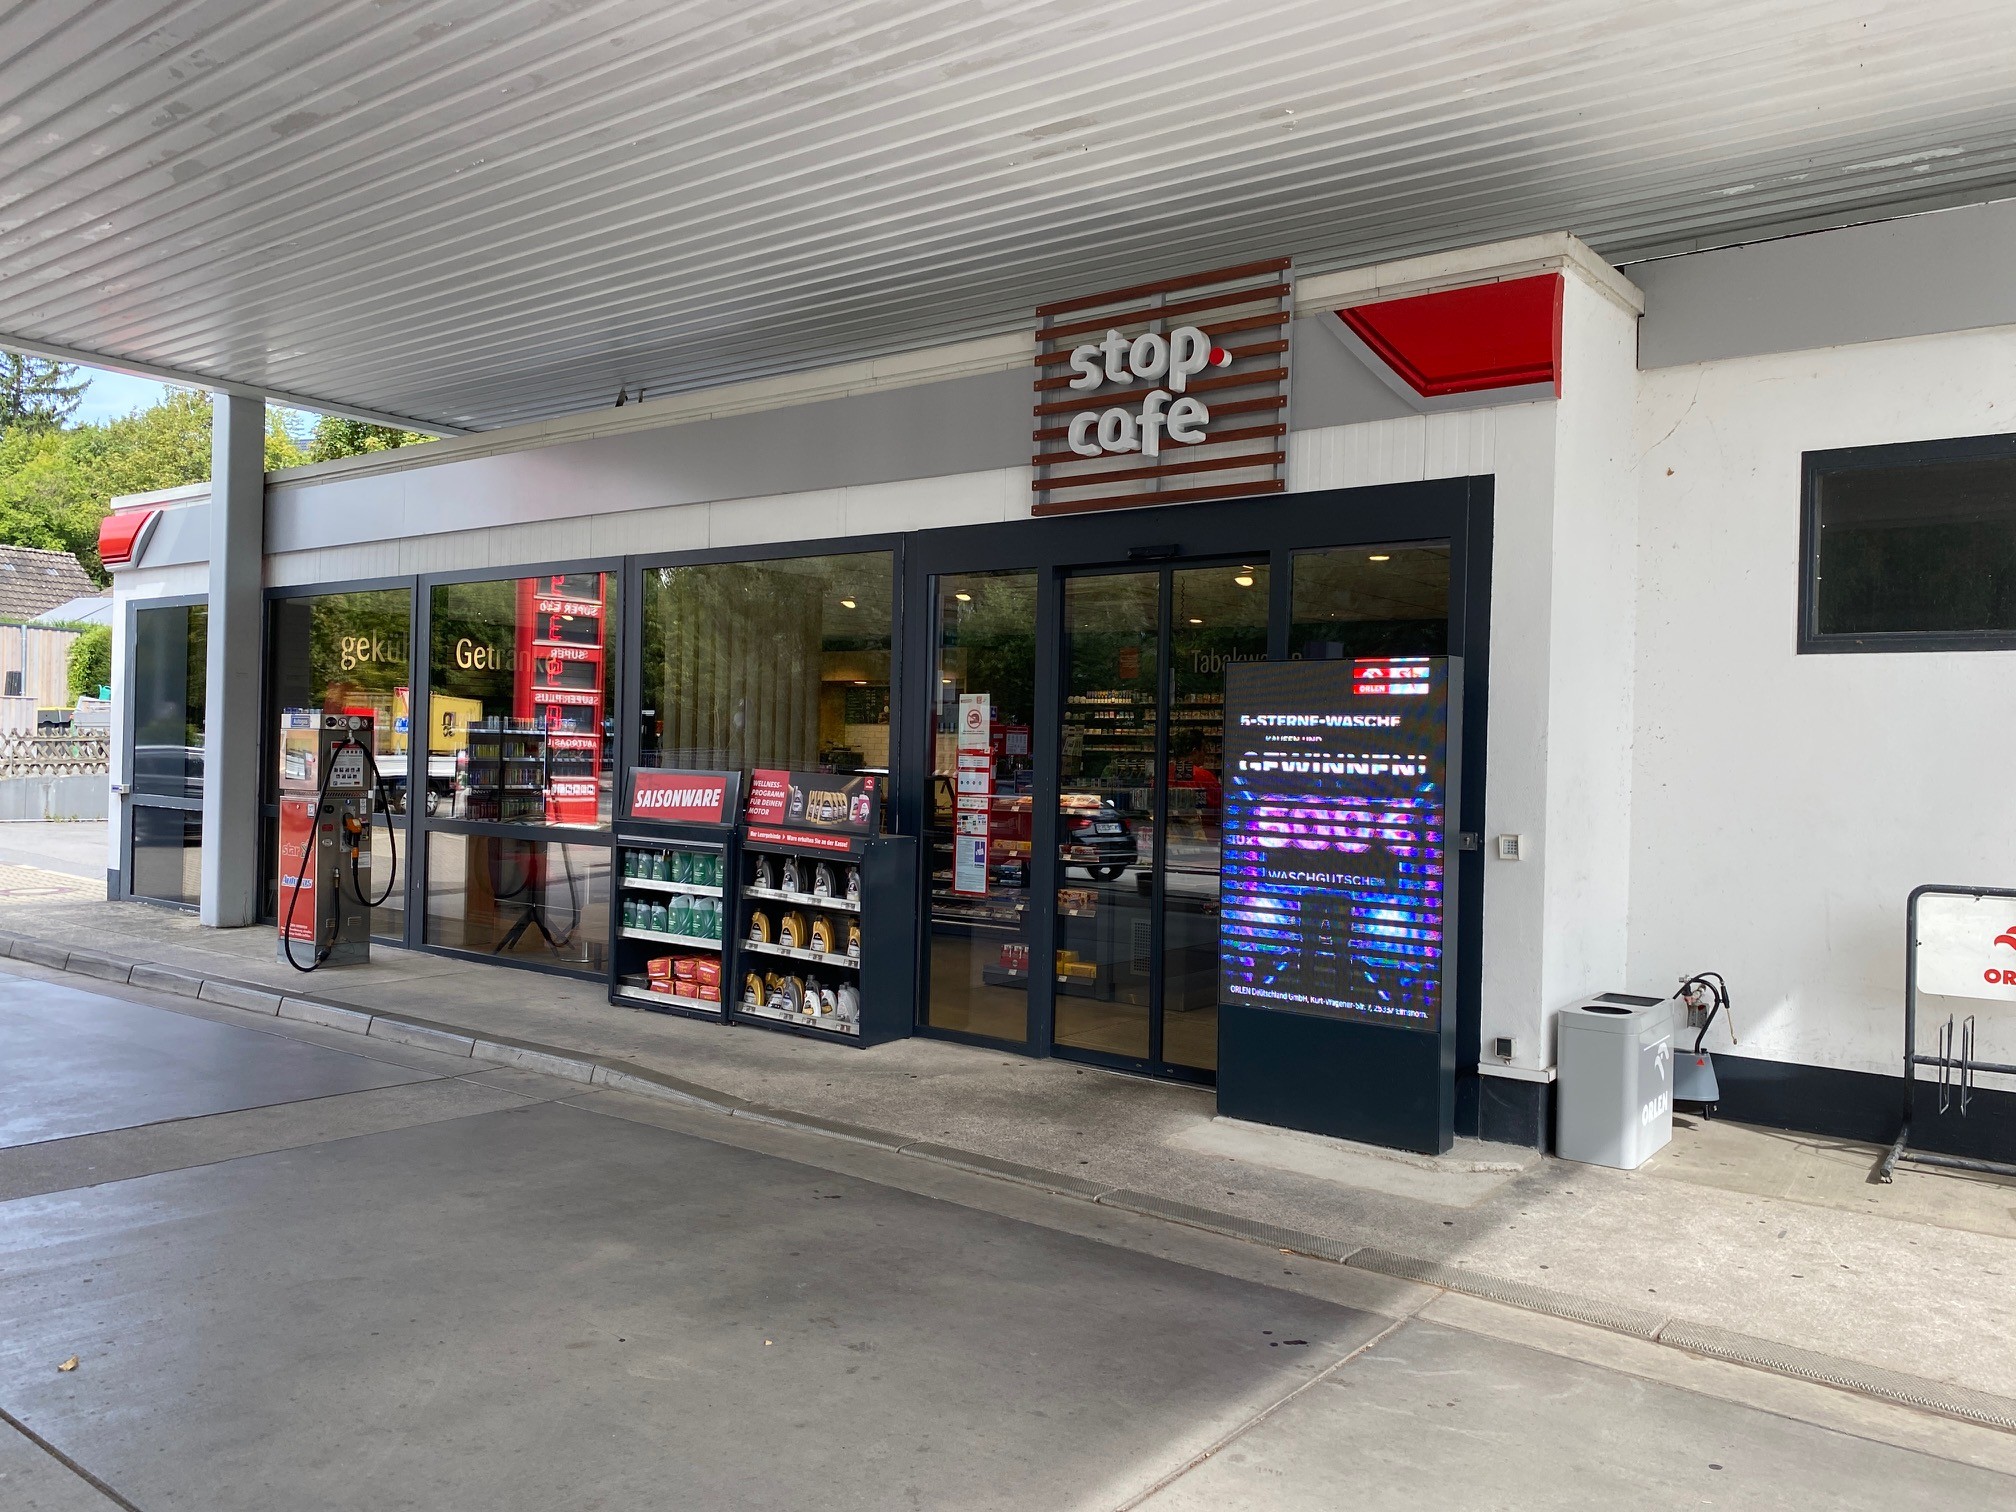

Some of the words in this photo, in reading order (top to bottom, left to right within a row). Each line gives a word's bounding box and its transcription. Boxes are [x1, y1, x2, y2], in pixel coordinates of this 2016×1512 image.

[1068, 389, 1210, 457] cafe
[1358, 685, 1386, 693] ORLEN
[753, 780, 783, 788] WELLNESS-
[635, 789, 722, 808] SAISONWARE
[751, 789, 785, 798] PROGRAMM
[750, 797, 761, 806] FÜR
[761, 799, 783, 808] DEINEN
[748, 808, 770, 816] MOTOR
[282, 843, 299, 857] star
[1230, 985, 1251, 995] ORLEN
[1251, 988, 1288, 1000] Deutschland
[1288, 993, 1310, 1003] GmbH,
[1641, 1090, 1668, 1127] ORLEN
